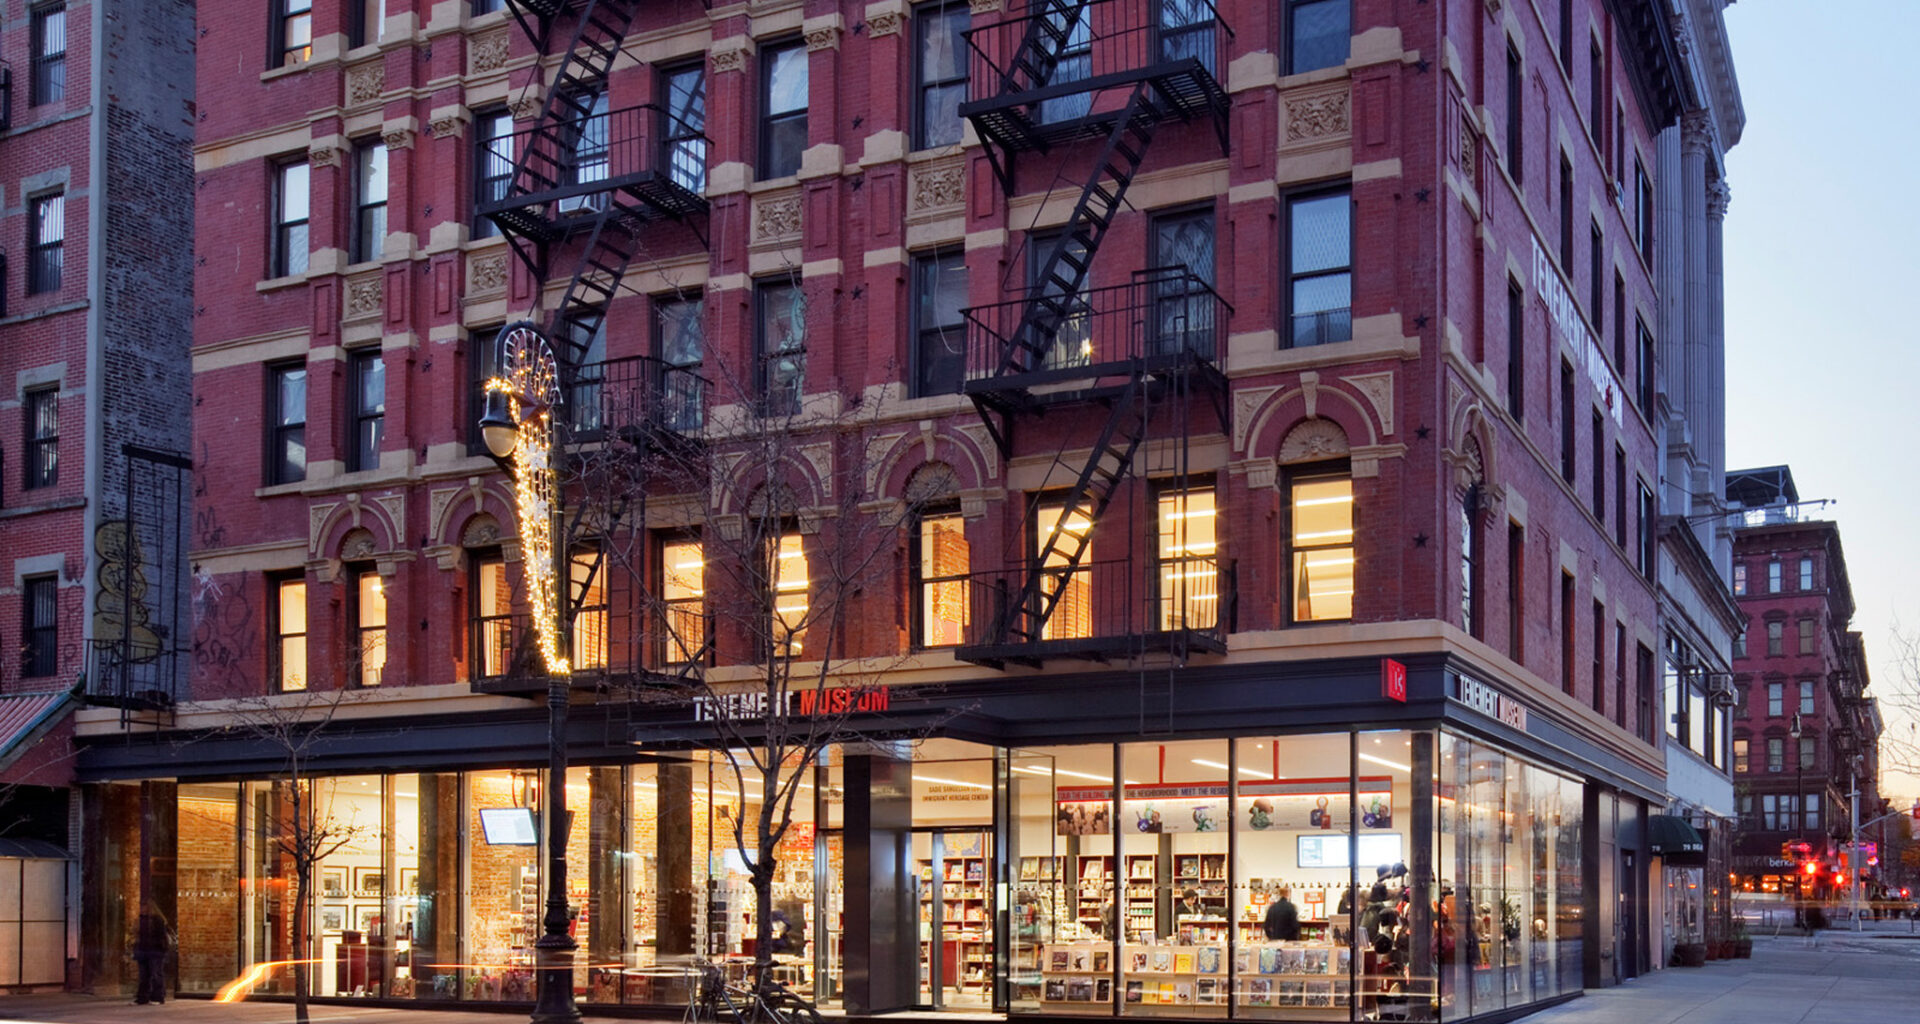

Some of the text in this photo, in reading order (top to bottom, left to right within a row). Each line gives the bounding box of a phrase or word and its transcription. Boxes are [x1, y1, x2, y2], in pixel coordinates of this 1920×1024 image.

[1530, 233, 1586, 367] TENEMENT
[801, 685, 889, 716] MUSEUM
[1460, 674, 1527, 732] TENEMENT MUSEUM
[1126, 789, 1137, 798] THE
[1138, 788, 1178, 797] NEIGHBORHOOD
[1180, 787, 1197, 796] MEET
[1199, 786, 1209, 795] THE
